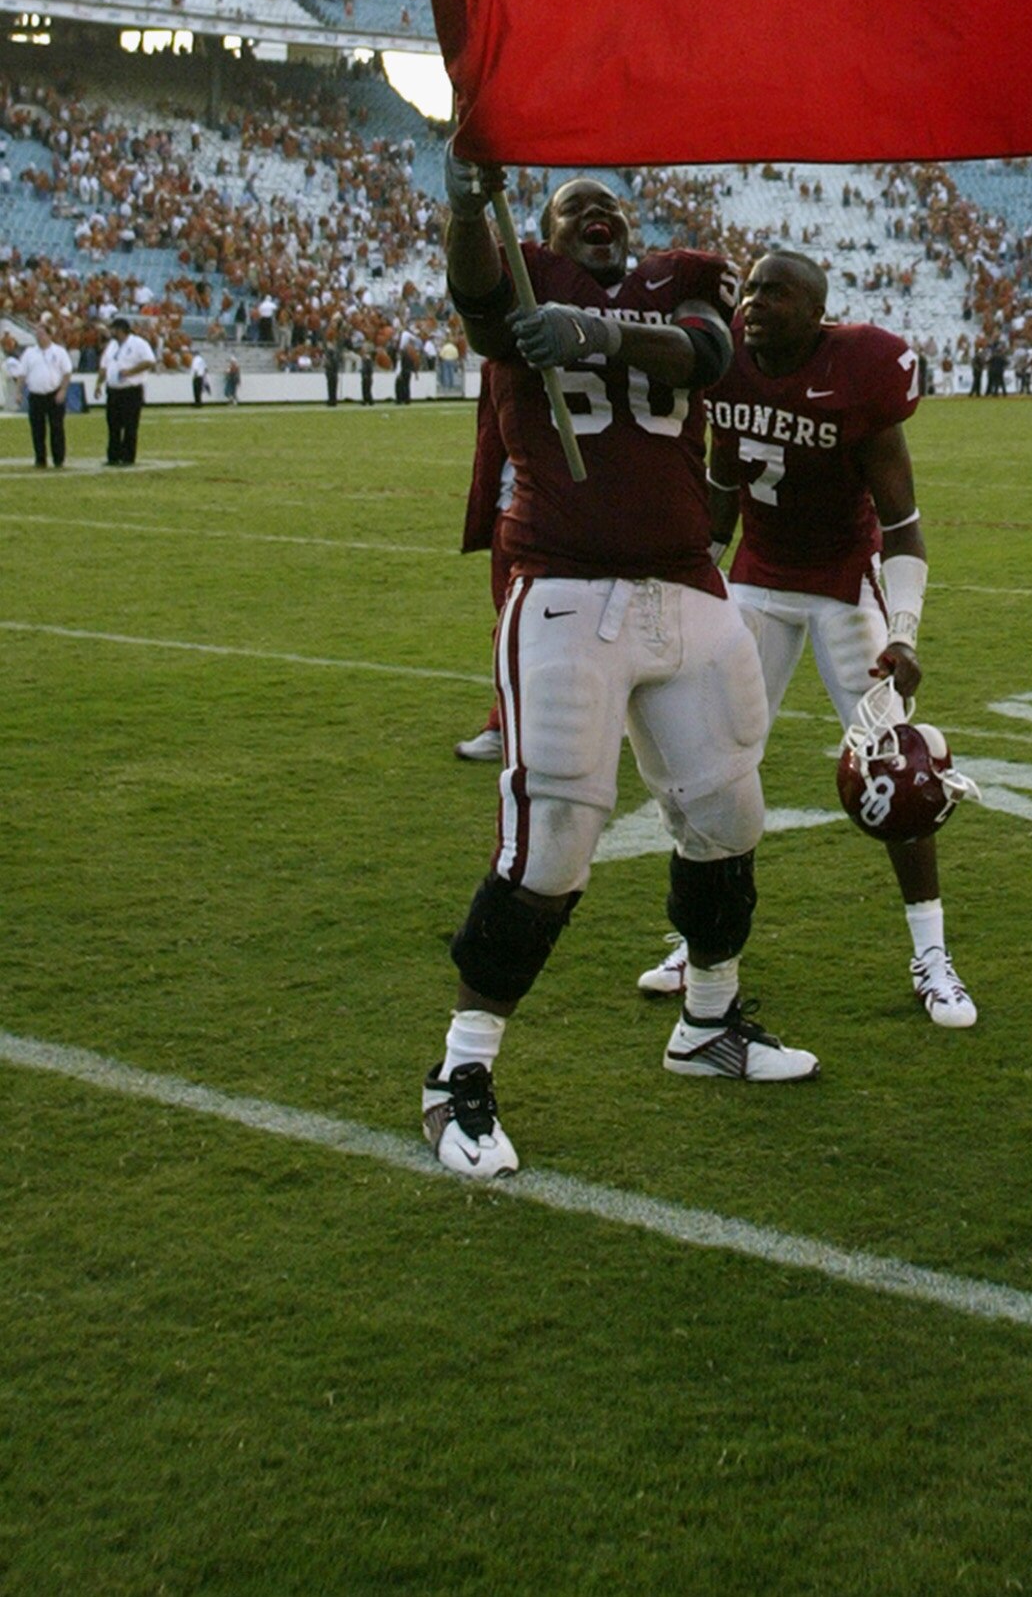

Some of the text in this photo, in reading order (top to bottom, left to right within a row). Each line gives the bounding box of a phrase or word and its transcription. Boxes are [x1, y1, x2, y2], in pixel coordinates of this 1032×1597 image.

[897, 349, 919, 401] 7
[703, 399, 838, 448] SOONERS
[738, 437, 786, 506] 7
